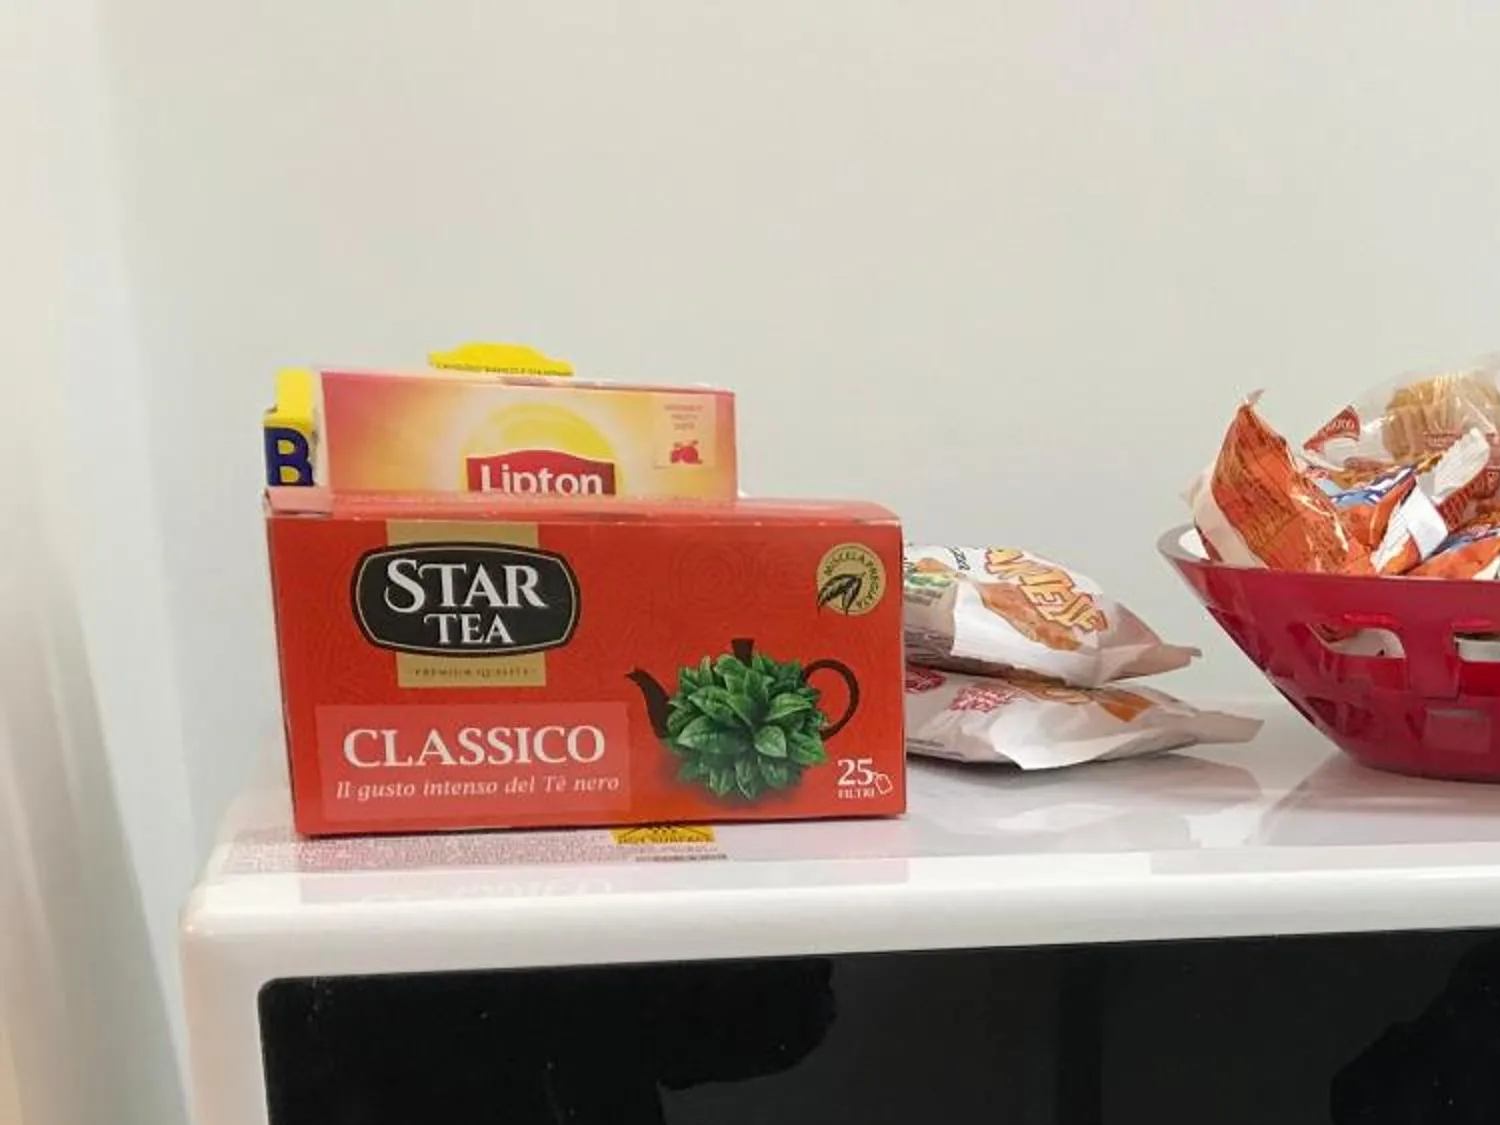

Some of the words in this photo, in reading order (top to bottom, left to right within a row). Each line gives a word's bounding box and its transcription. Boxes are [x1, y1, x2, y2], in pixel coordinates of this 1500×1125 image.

[263, 427, 314, 487] B
[480, 464, 604, 496] Lipton
[384, 559, 550, 613] STAR
[423, 613, 515, 645] TEA
[343, 725, 606, 768] CLASSICO
[336, 780, 351, 799] Il
[357, 780, 415, 801] gusto
[423, 775, 498, 797] intenso
[505, 774, 535, 794] del
[574, 776, 620, 792] nero
[837, 758, 873, 786] 25
